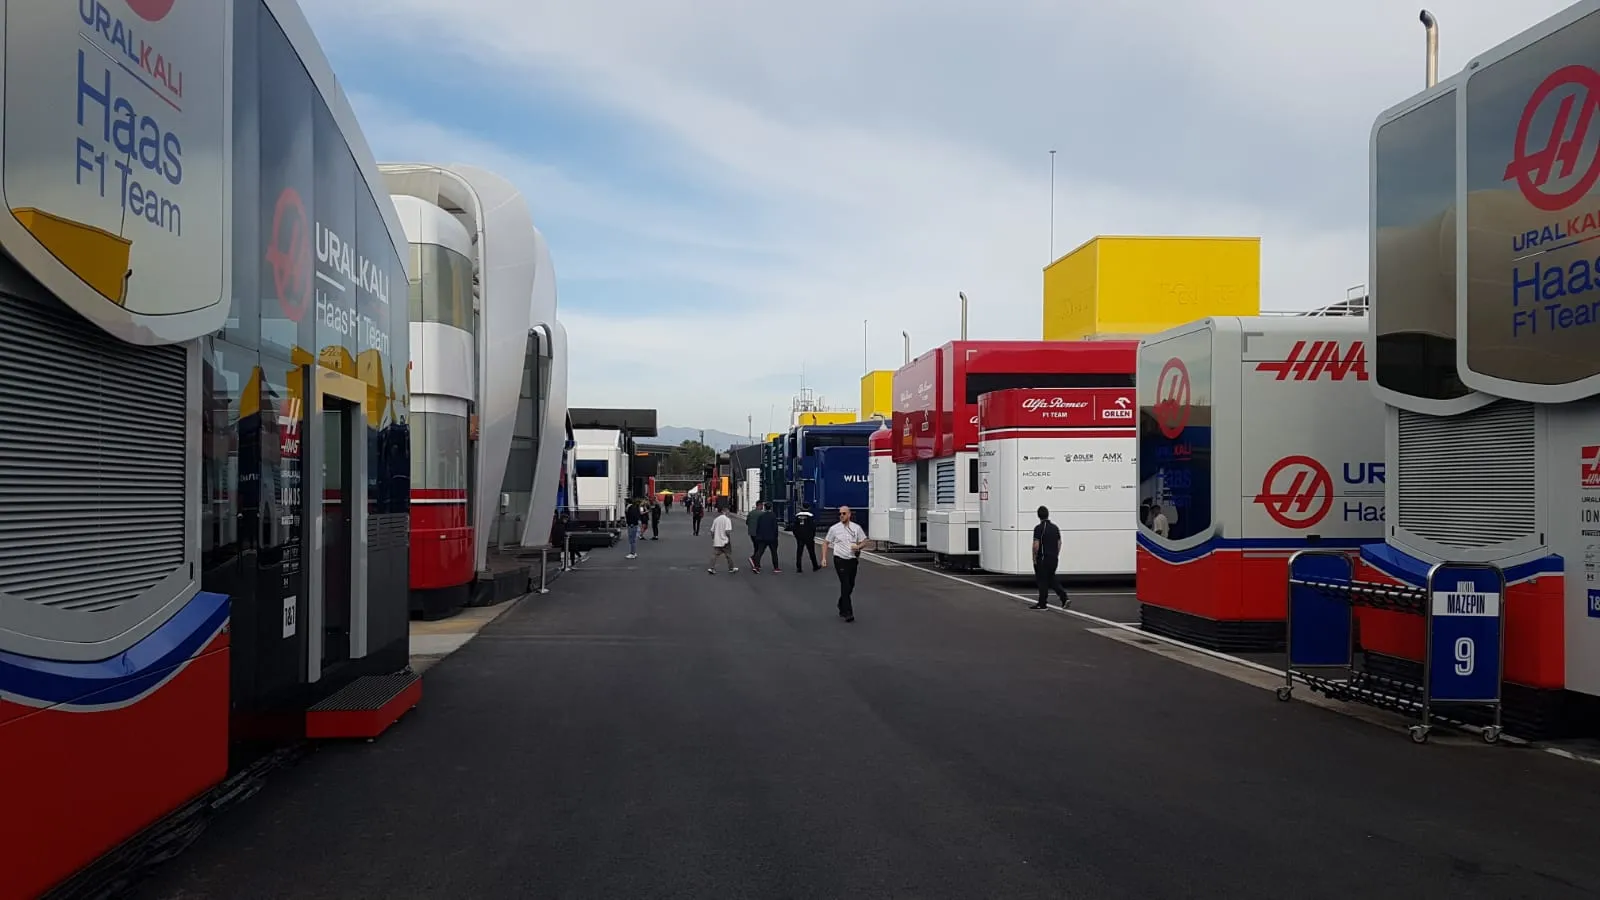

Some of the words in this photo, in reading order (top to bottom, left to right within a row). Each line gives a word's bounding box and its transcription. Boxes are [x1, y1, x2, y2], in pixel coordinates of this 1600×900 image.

[79, 0, 182, 98] URALKALI
[77, 49, 182, 185] Haas
[76, 137, 105, 197] F1
[114, 160, 181, 237] Team
[1512, 210, 1600, 252] URALKA
[315, 221, 389, 305] URALKALI
[316, 288, 348, 335] Haas
[349, 307, 361, 343] F1
[363, 315, 389, 356] Team
[1513, 309, 1537, 338] F1
[1022, 398, 1048, 412] Alfa
[1048, 397, 1089, 408] Romeo
[1104, 410, 1131, 418] ORLEN
[1447, 594, 1486, 614] MAZEPIN
[1454, 637, 1475, 676] 9
